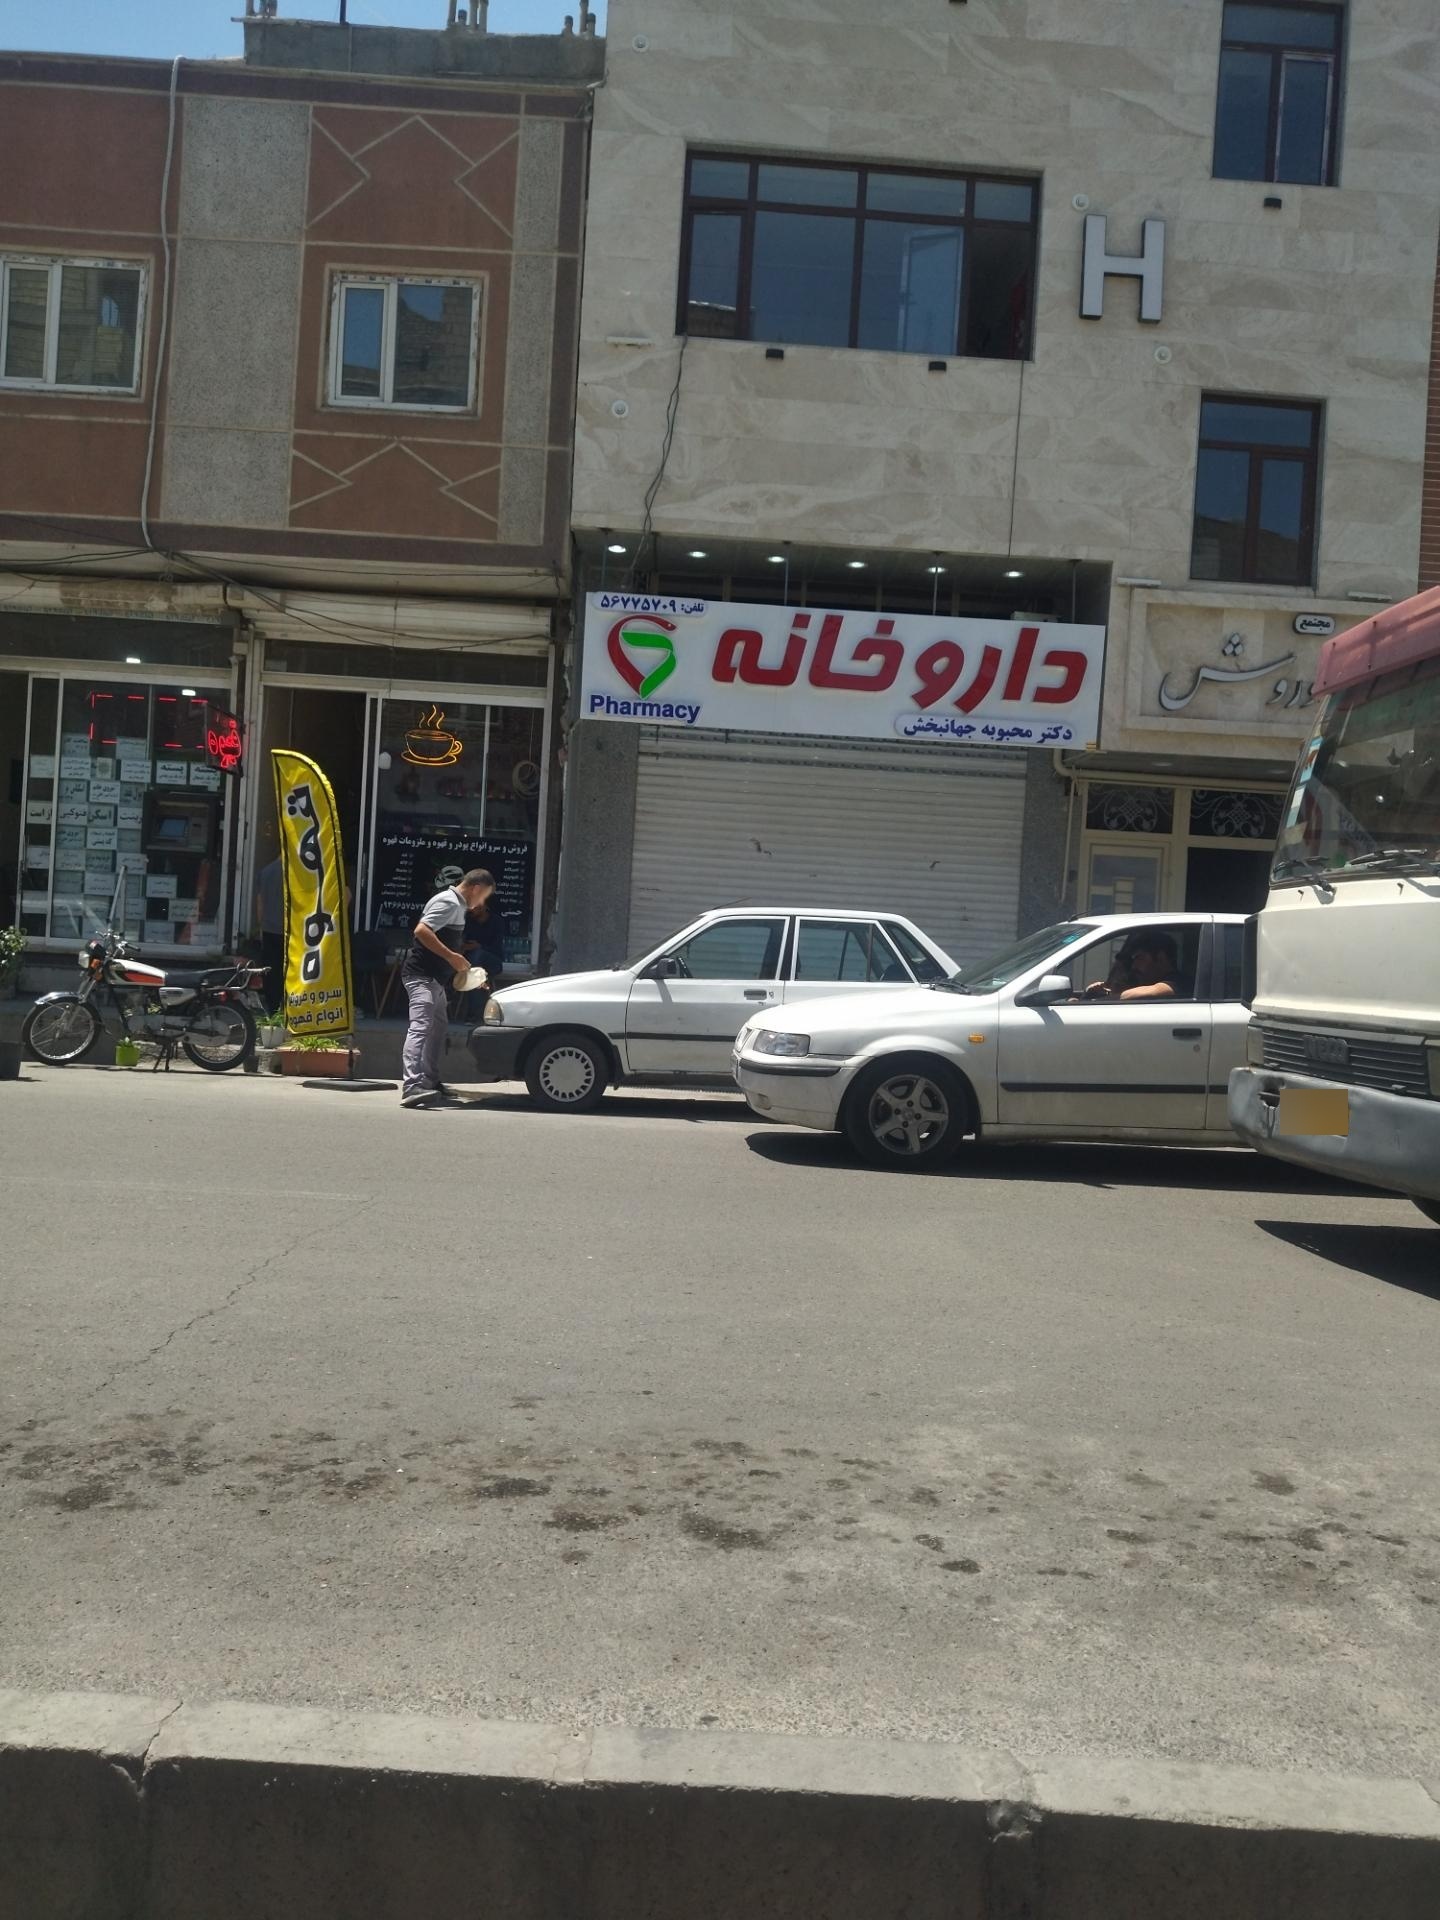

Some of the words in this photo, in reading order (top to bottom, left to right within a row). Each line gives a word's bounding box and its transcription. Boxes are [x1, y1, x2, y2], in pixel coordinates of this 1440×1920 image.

[1079, 214, 1166, 323] H
[600, 594, 677, 612] ۵۶۷۷۵۷۰۹
[1299, 618, 1331, 631] مجتمع
[711, 613, 1088, 714] داروخانه
[590, 694, 701, 724] Pharmacy
[903, 717, 976, 738] جهانبخش
[981, 723, 1033, 742] محبوبه
[1037, 725, 1073, 743] دکتر
[507, 843, 528, 854] فروش
[286, 784, 334, 982] قهوه
[309, 991, 316, 1004] و
[318, 989, 342, 1004] سرو
[316, 1007, 344, 1026] انواع
